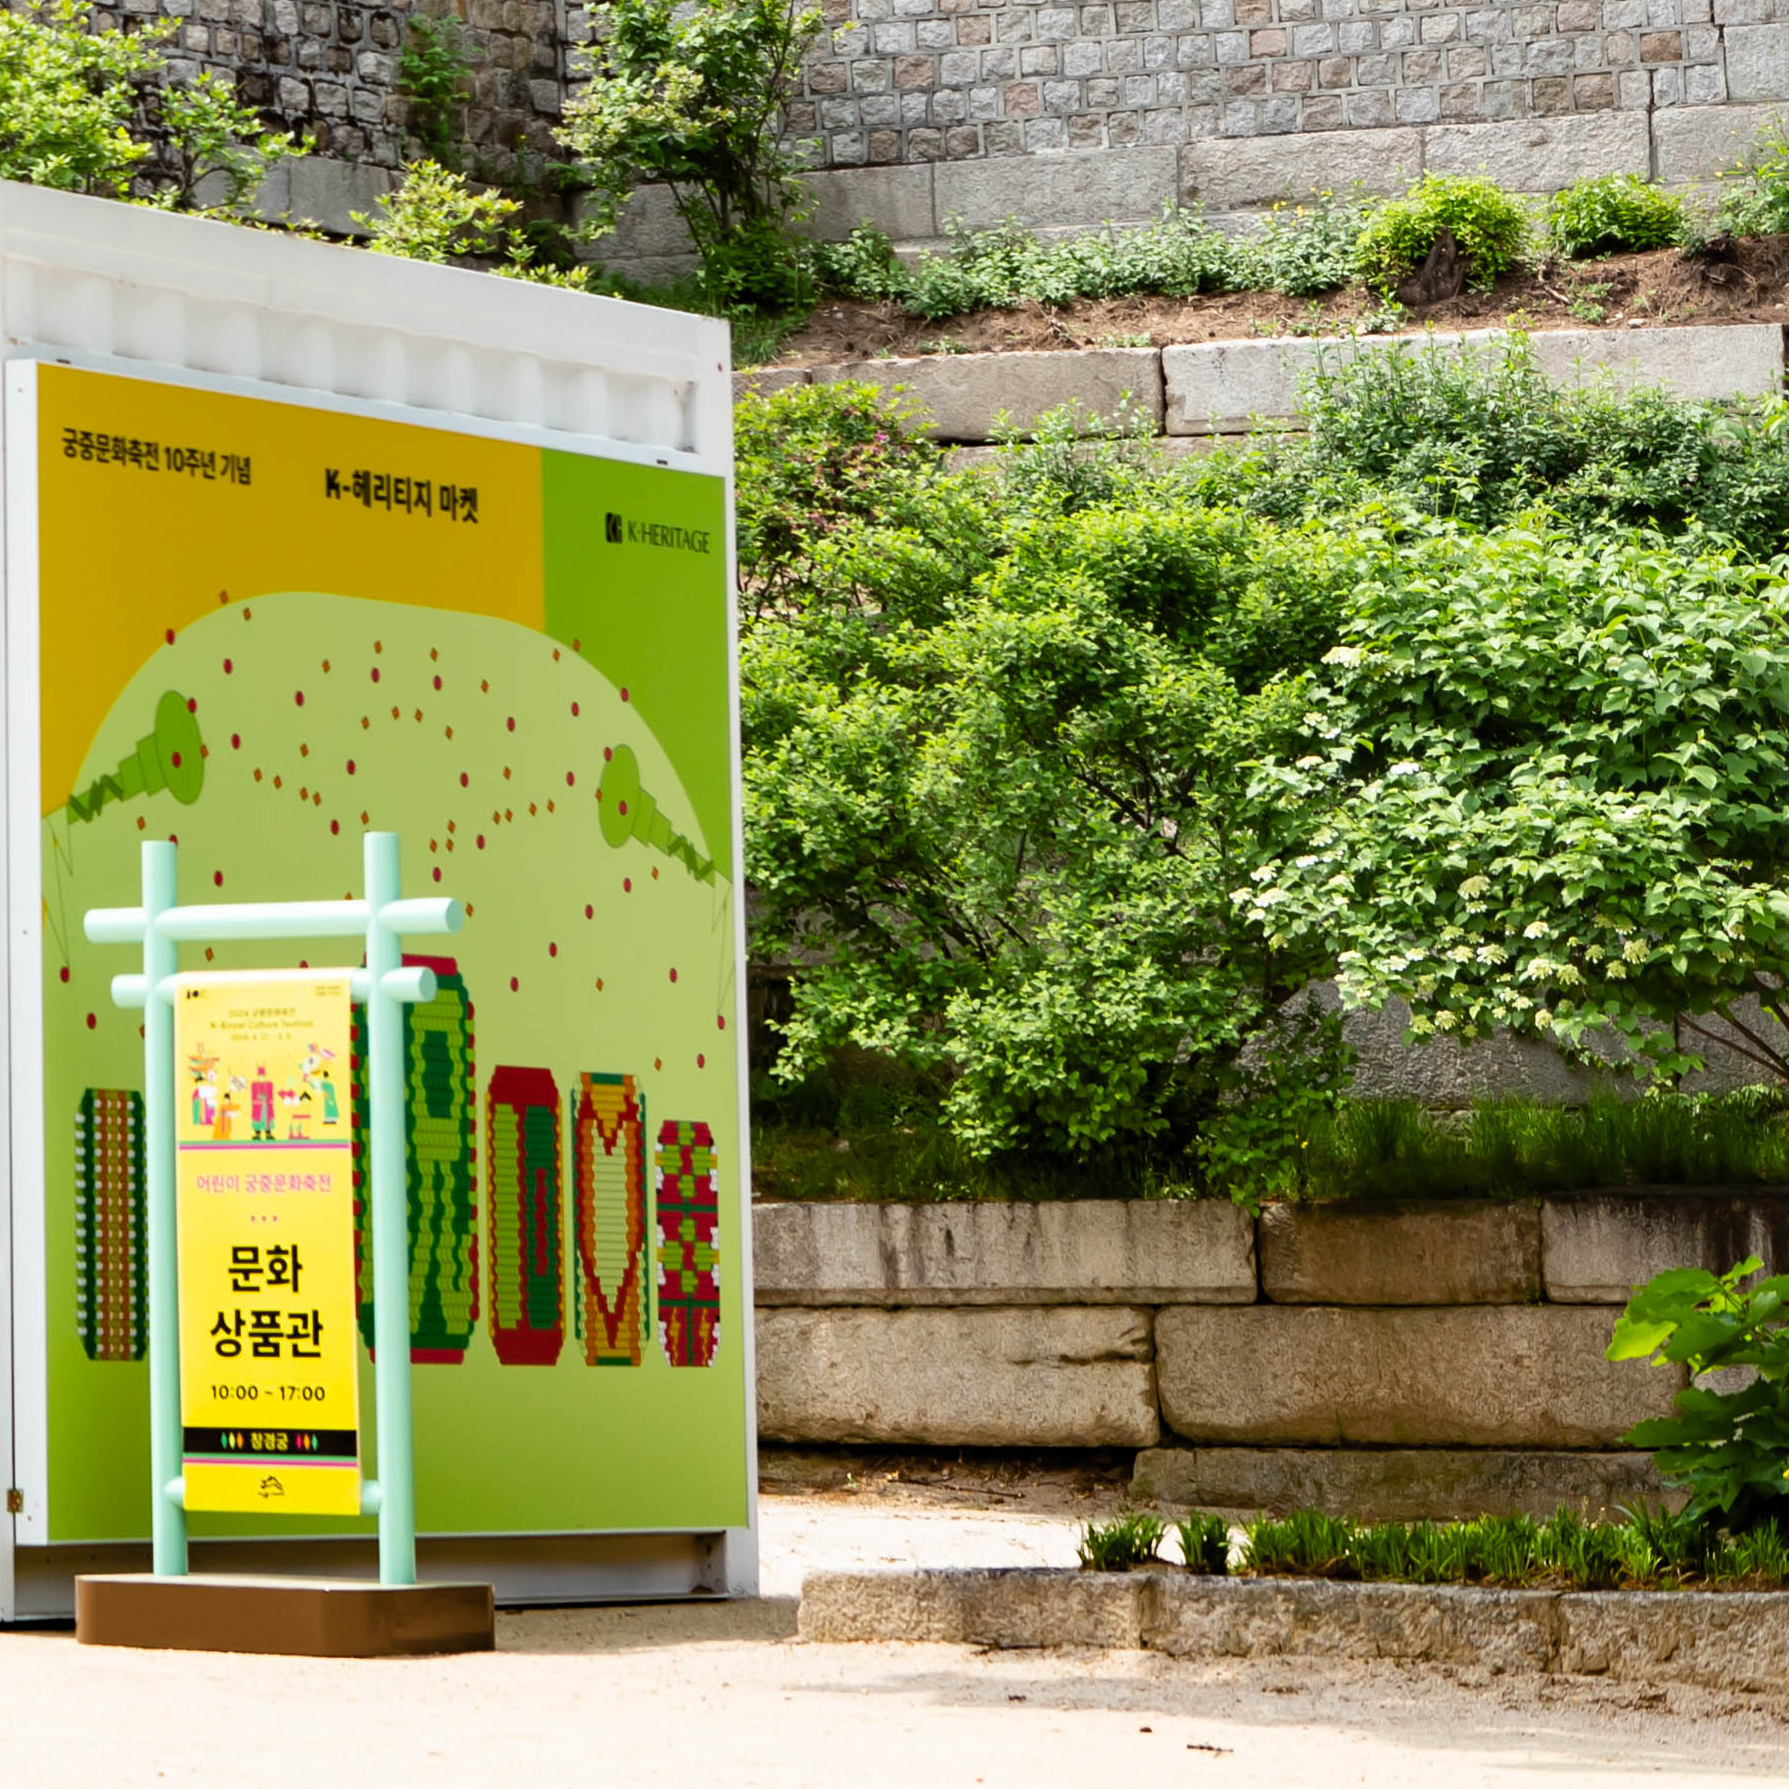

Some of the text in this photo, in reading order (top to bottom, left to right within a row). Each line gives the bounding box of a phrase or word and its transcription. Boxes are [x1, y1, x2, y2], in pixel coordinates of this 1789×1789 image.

[62, 427, 251, 486] 궁중문화축전 10주년 기념
[325, 468, 478, 524] K-헤리티지 마켓
[197, 1174, 331, 1193] 어린이 궁중문화축전
[228, 1244, 303, 1293] 문화
[210, 1309, 324, 1358] 상품관
[211, 1385, 258, 1400] 10:00
[280, 1385, 326, 1401] 17:00
